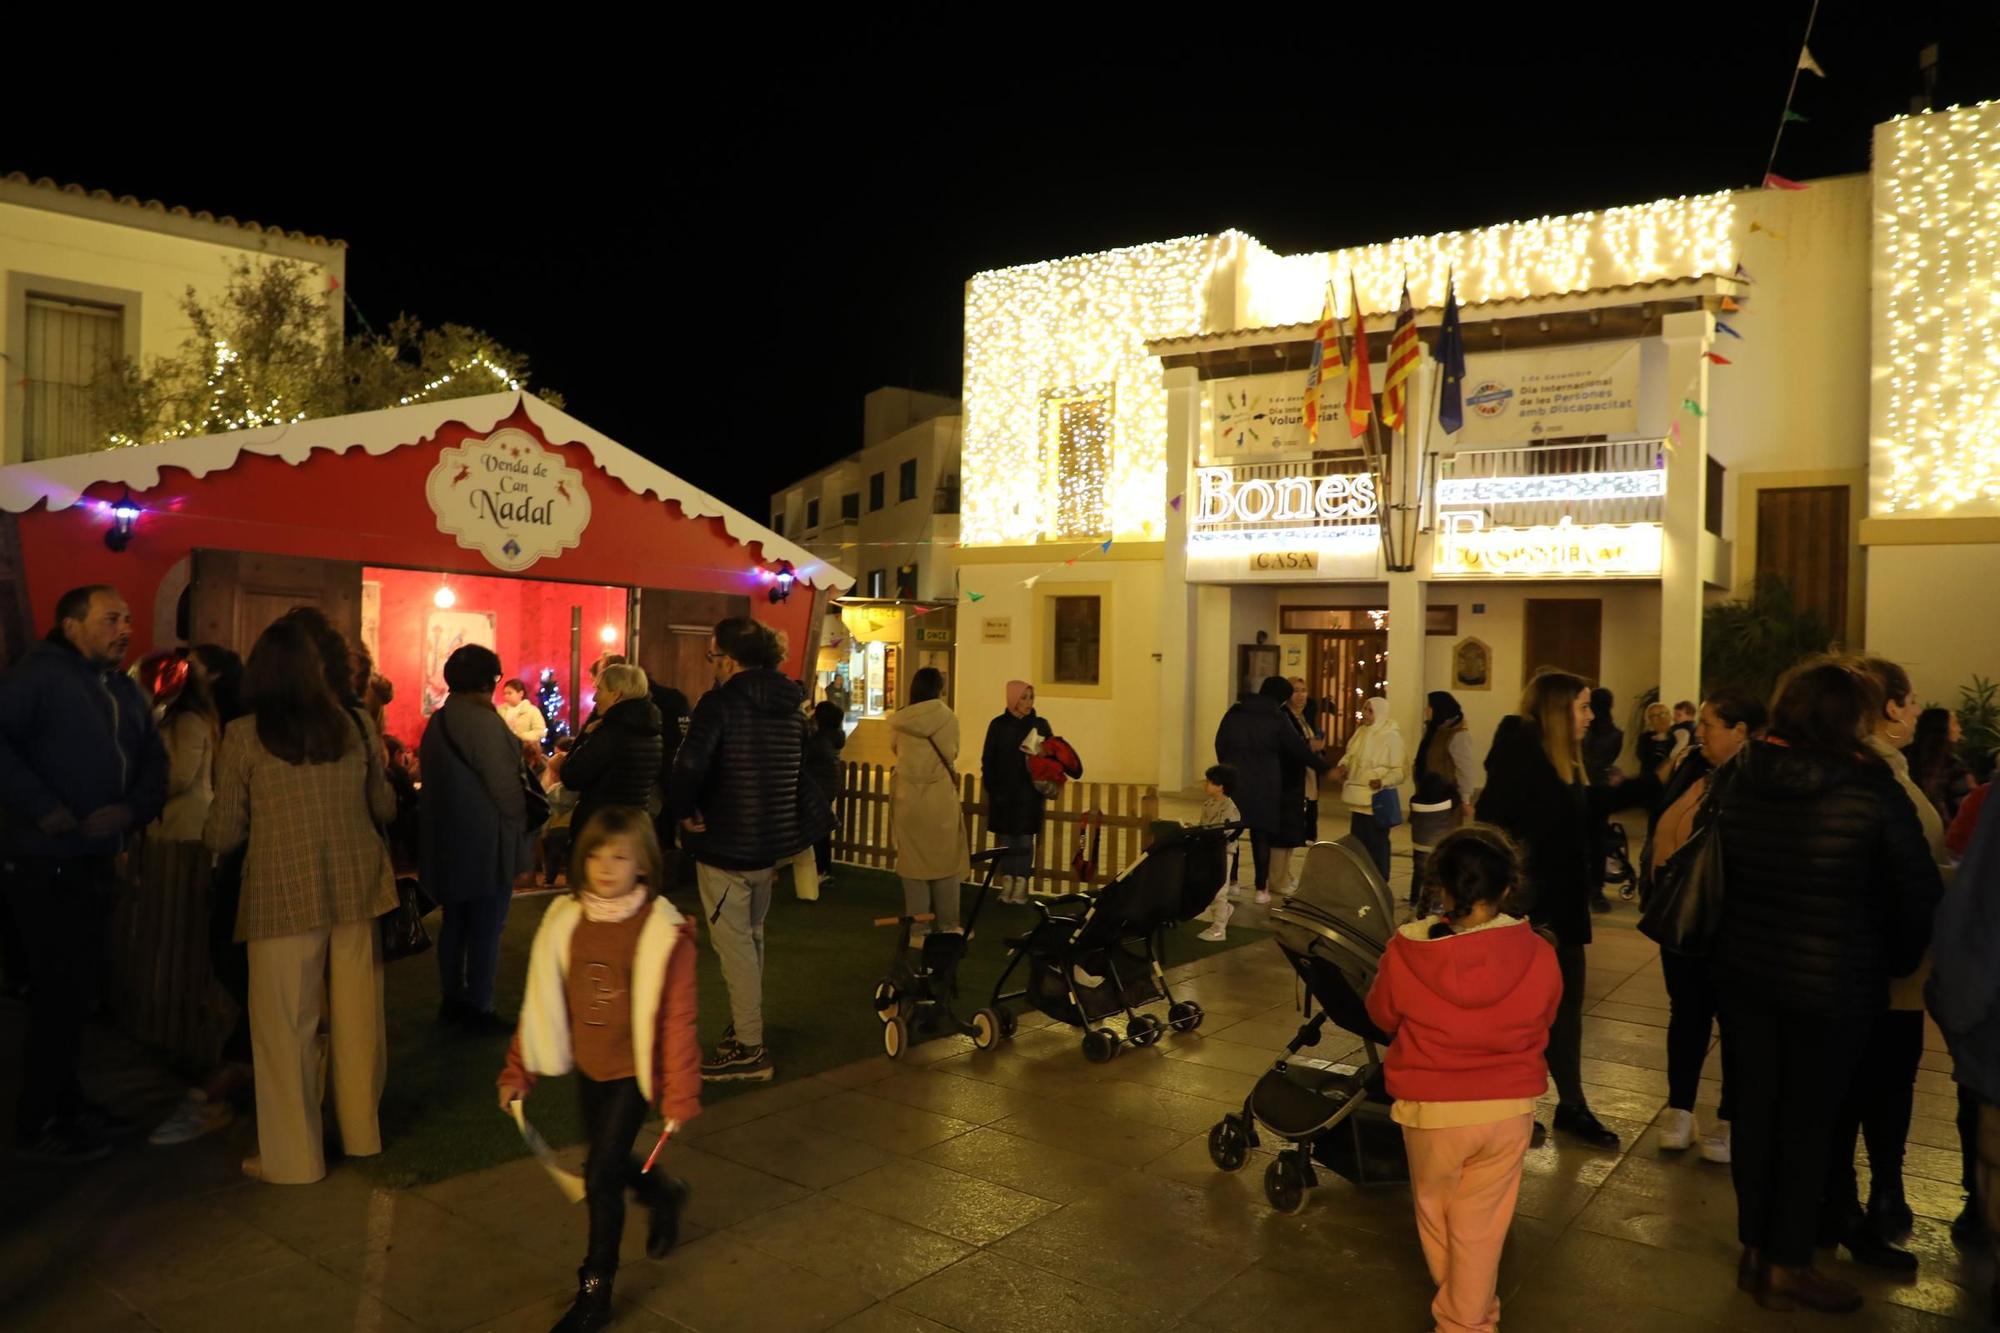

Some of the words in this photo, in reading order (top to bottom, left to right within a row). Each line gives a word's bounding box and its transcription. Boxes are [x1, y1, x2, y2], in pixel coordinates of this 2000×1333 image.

[1520, 386, 1537, 395] Dia
[1541, 377, 1613, 393] Internacional
[1519, 397, 1532, 406] de
[1535, 396, 1551, 405] les
[1554, 390, 1612, 403] Persones
[1269, 407, 1283, 415] Dia
[1519, 407, 1546, 417] amb
[1550, 399, 1632, 415] Discapacitat
[1269, 412, 1338, 425] Volunriat
[480, 454, 529, 475] Venda
[533, 462, 548, 478] de
[499, 476, 529, 494] Can
[1190, 468, 1378, 522] Bones
[469, 489, 555, 530] Nadal
[1256, 552, 1313, 569] CASA
